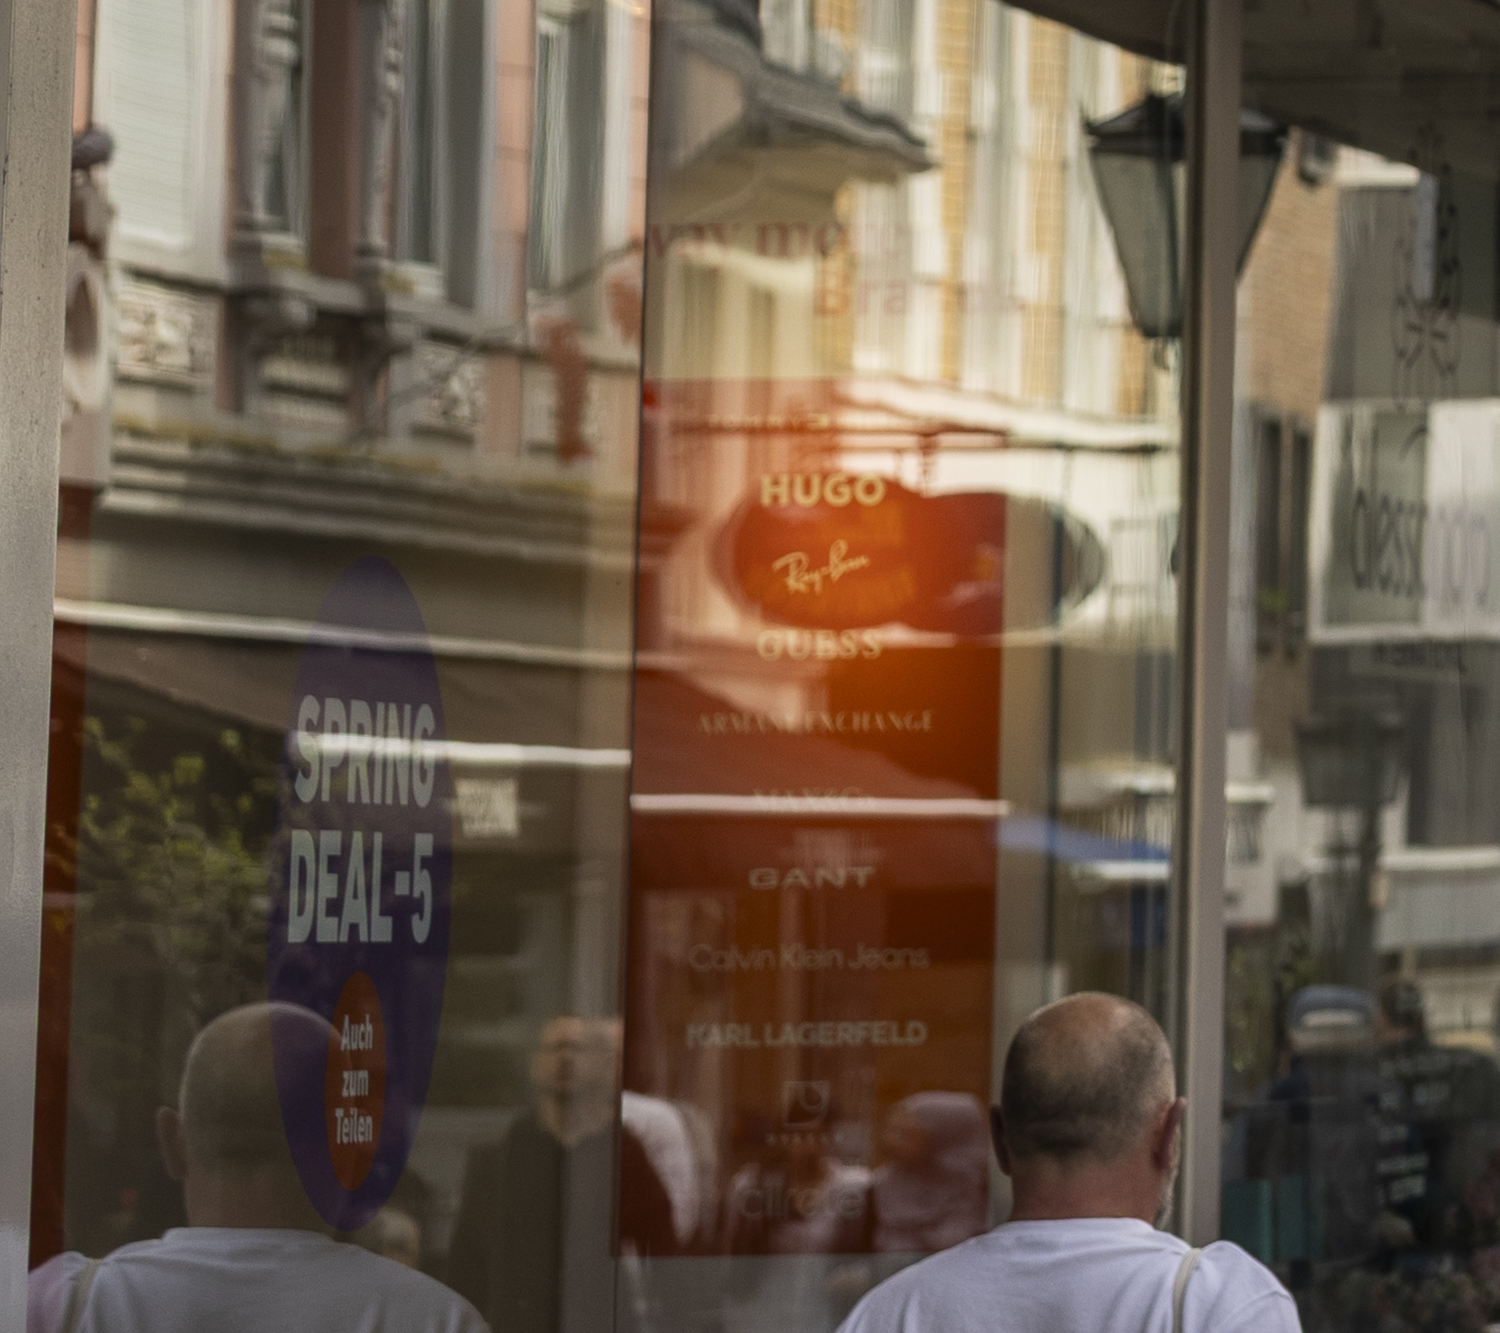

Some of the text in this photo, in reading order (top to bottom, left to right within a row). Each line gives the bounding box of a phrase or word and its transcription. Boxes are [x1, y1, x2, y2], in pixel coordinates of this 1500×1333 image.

[760, 473, 887, 507] HUGO
[771, 538, 871, 595] Ray-Ban
[755, 629, 884, 662] GUESS
[804, 710, 933, 734] EXCHANGE
[294, 694, 436, 808] SPRING
[287, 829, 434, 944] DEAL-5
[748, 866, 877, 891] GANT
[688, 942, 930, 973] Calvin Klein Jeans
[340, 1014, 373, 1051] Auch
[686, 1020, 929, 1048] KARL LAGERFELD
[341, 1070, 369, 1098] zum
[335, 1107, 373, 1145] Teilen
